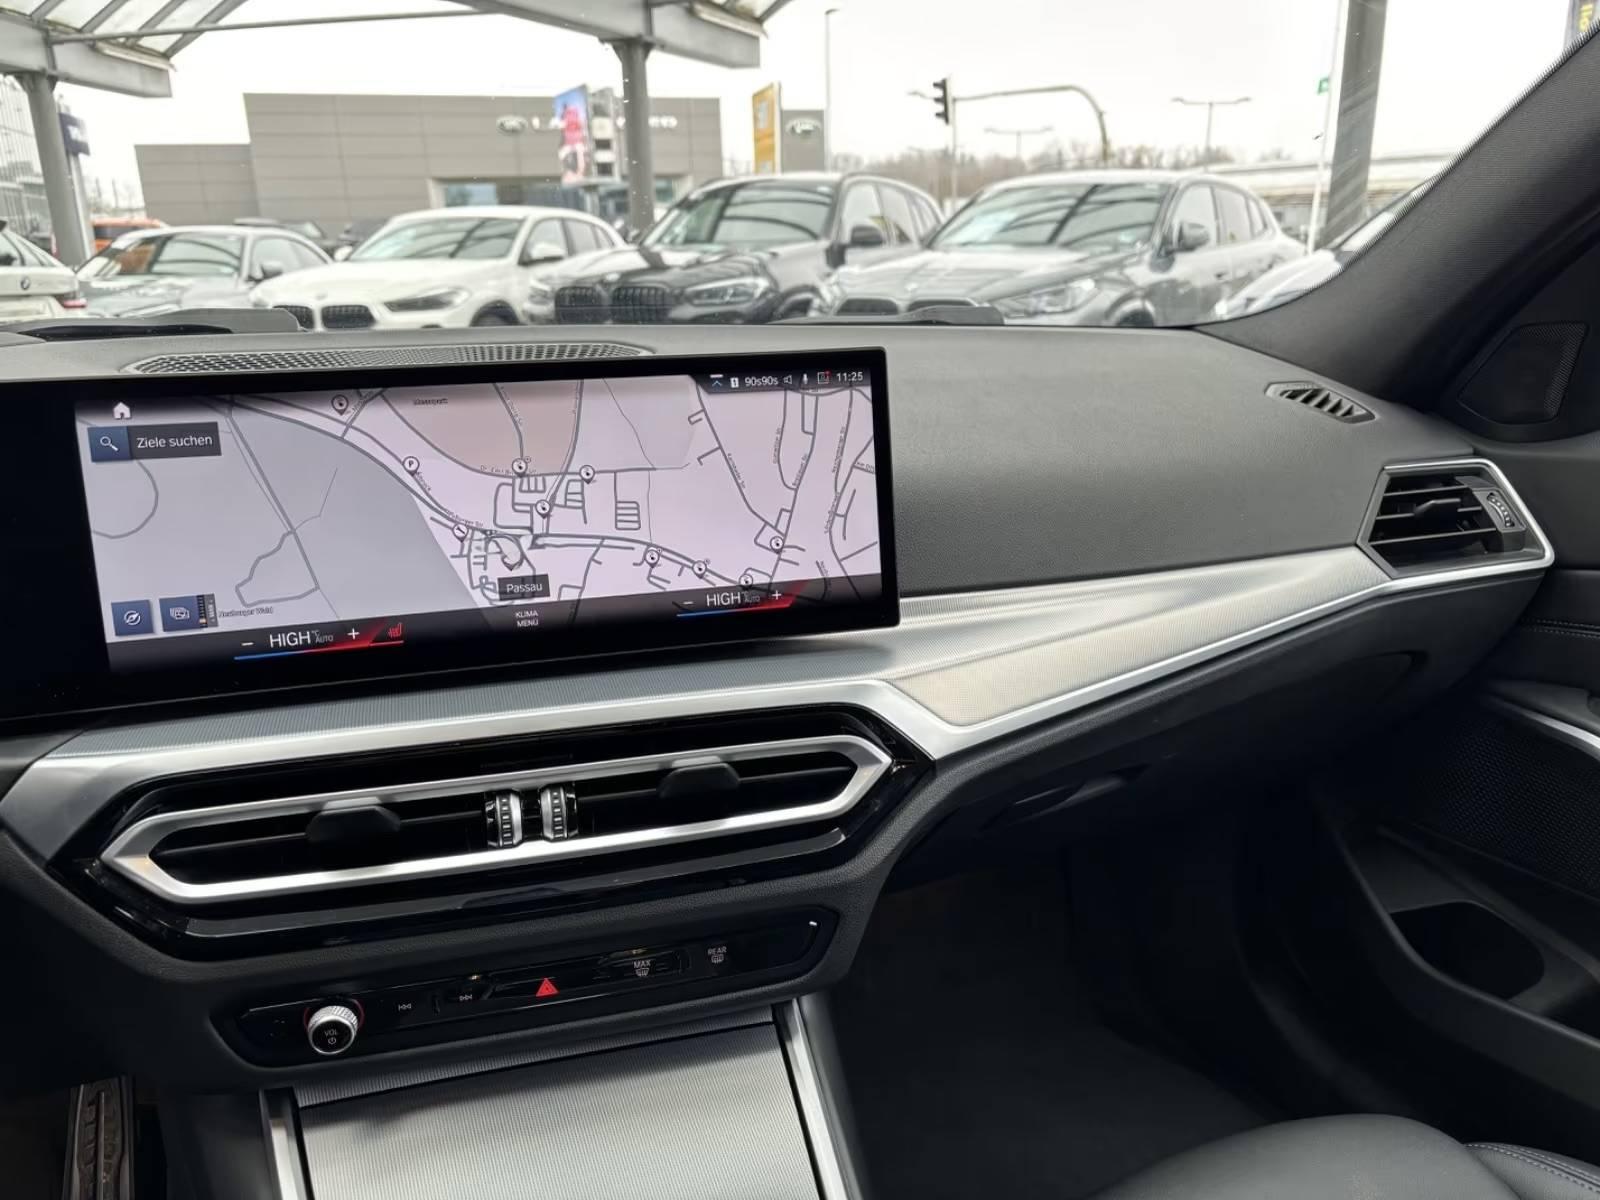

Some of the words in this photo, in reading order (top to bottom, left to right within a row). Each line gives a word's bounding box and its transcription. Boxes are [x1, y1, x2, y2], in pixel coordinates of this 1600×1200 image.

[745, 376, 779, 387] 90s90s
[836, 371, 864, 382] 11:25
[136, 437, 167, 449] Ziele
[168, 435, 213, 447] suchen
[506, 583, 543, 593] Passau
[706, 592, 741, 607] HIGH
[515, 610, 539, 619] KLIMA
[269, 631, 311, 648] HIGH
[707, 945, 727, 956] REAR
[633, 959, 651, 969] MAX
[324, 1029, 337, 1038] VOL
